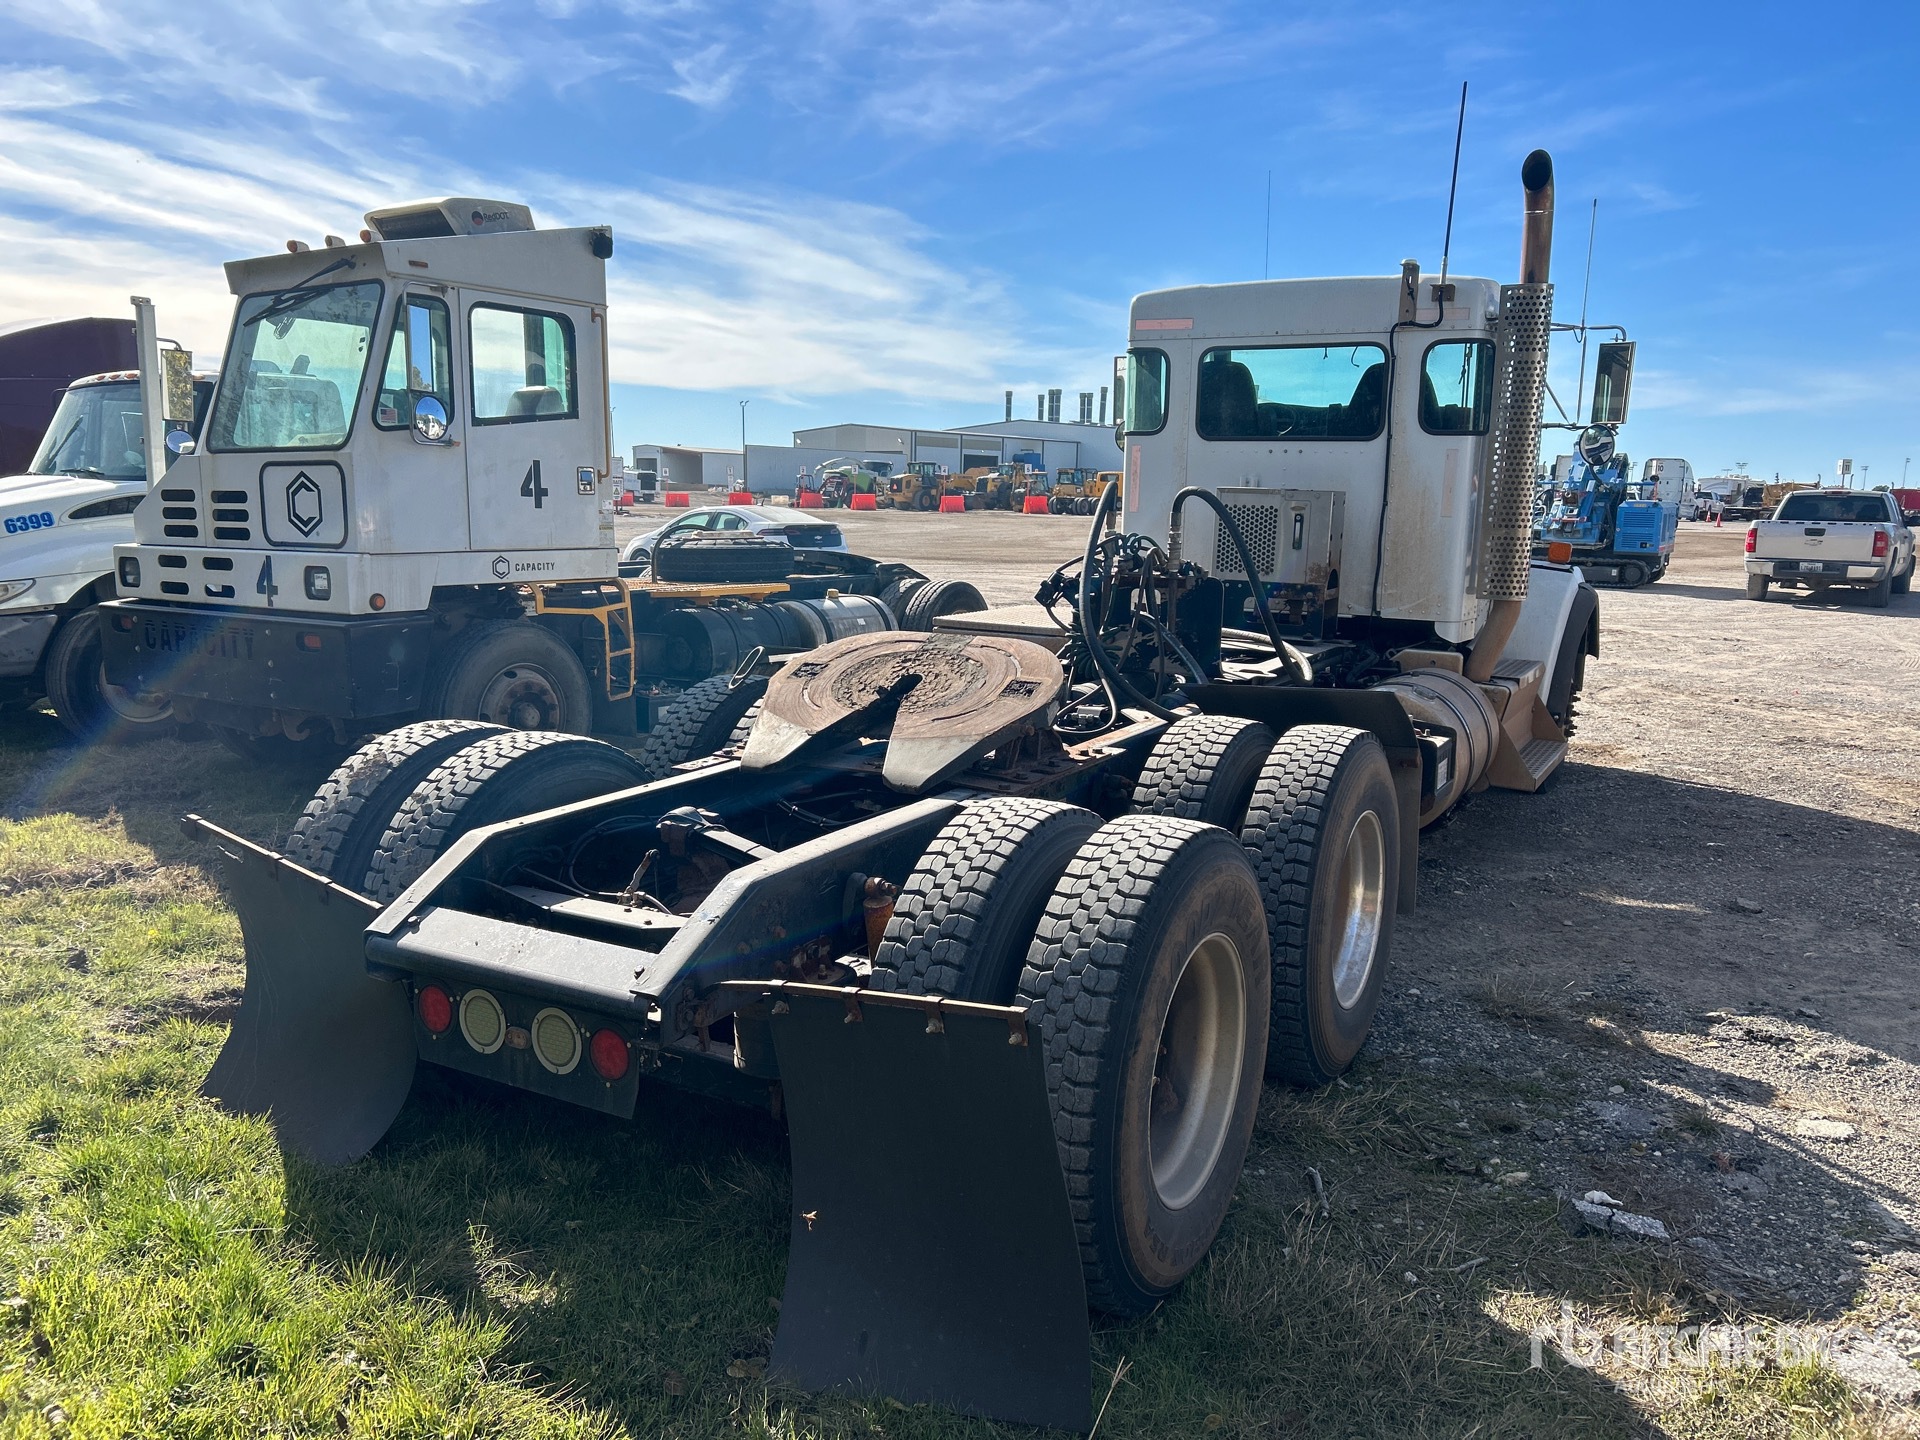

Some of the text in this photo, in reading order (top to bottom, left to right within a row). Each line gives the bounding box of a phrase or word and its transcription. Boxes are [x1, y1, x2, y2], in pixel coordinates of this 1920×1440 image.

[520, 459, 549, 509] 4
[3, 511, 55, 535] 6399
[256, 555, 279, 607] 4
[515, 562, 556, 572] CAPACITY
[144, 619, 255, 659] CAPACITY
